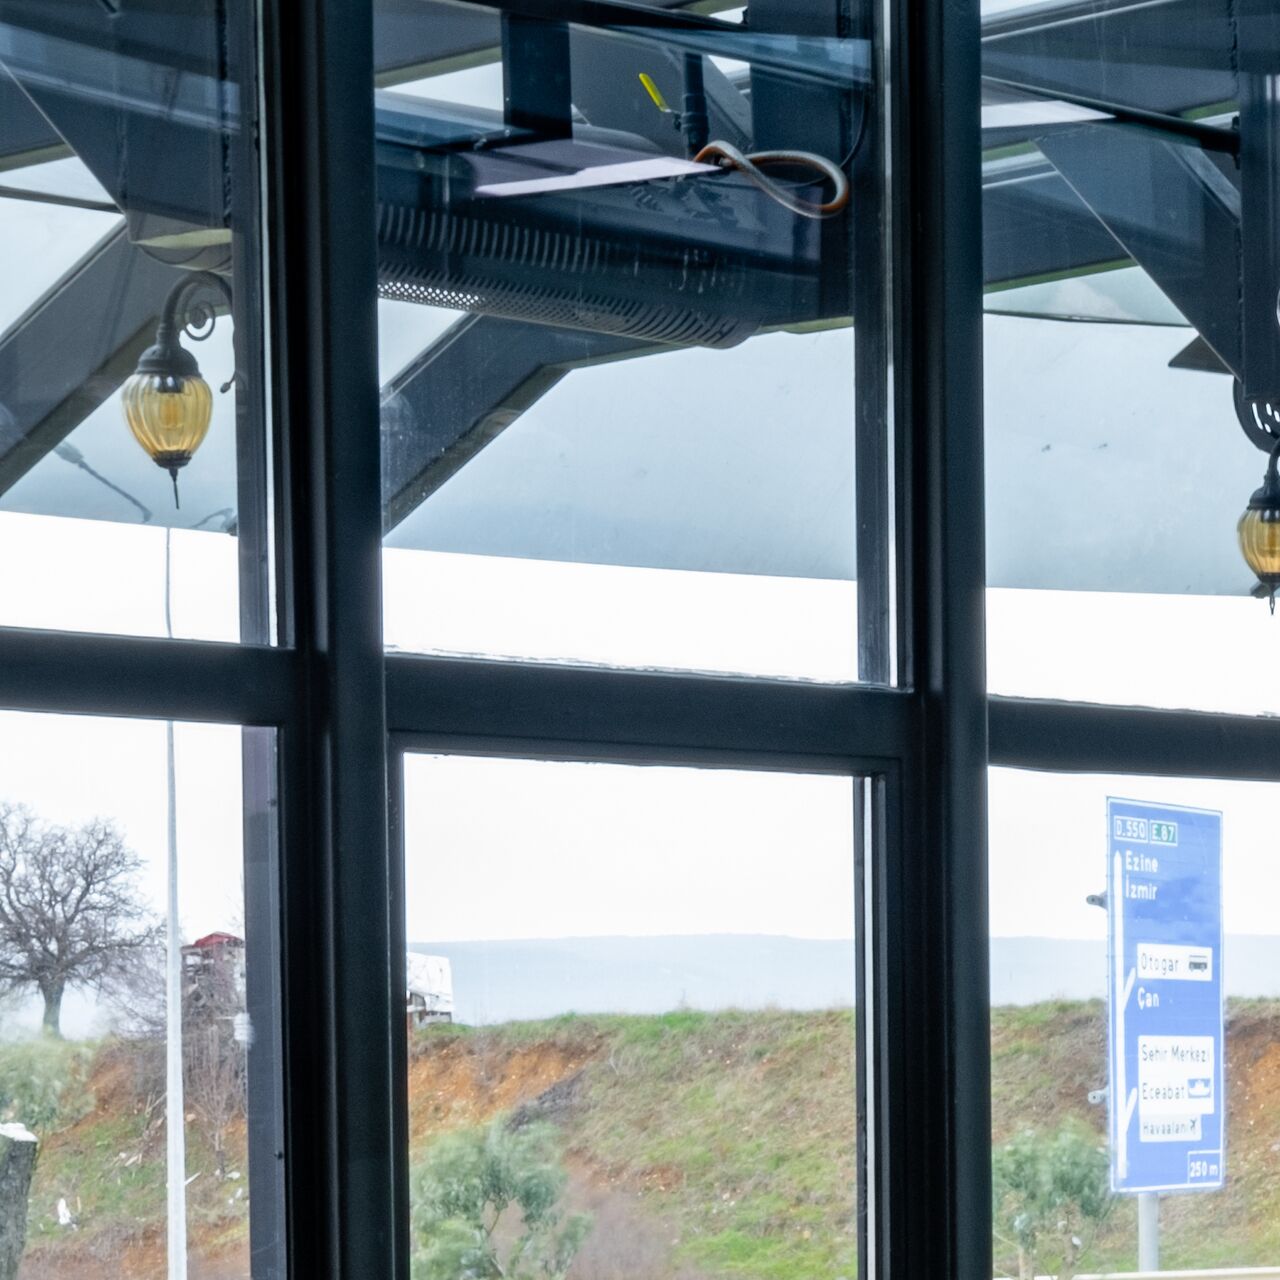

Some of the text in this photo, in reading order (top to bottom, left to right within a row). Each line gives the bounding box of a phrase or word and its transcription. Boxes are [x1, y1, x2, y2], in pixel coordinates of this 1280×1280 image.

[1116, 819, 1145, 839] D.550
[1125, 849, 1159, 873] Ezine
[1141, 952, 1179, 976] Otogar
[1137, 986, 1160, 1011] Çan
[1142, 1081, 1185, 1100] Eceabat
[1190, 1160, 1218, 1177] 250 m
